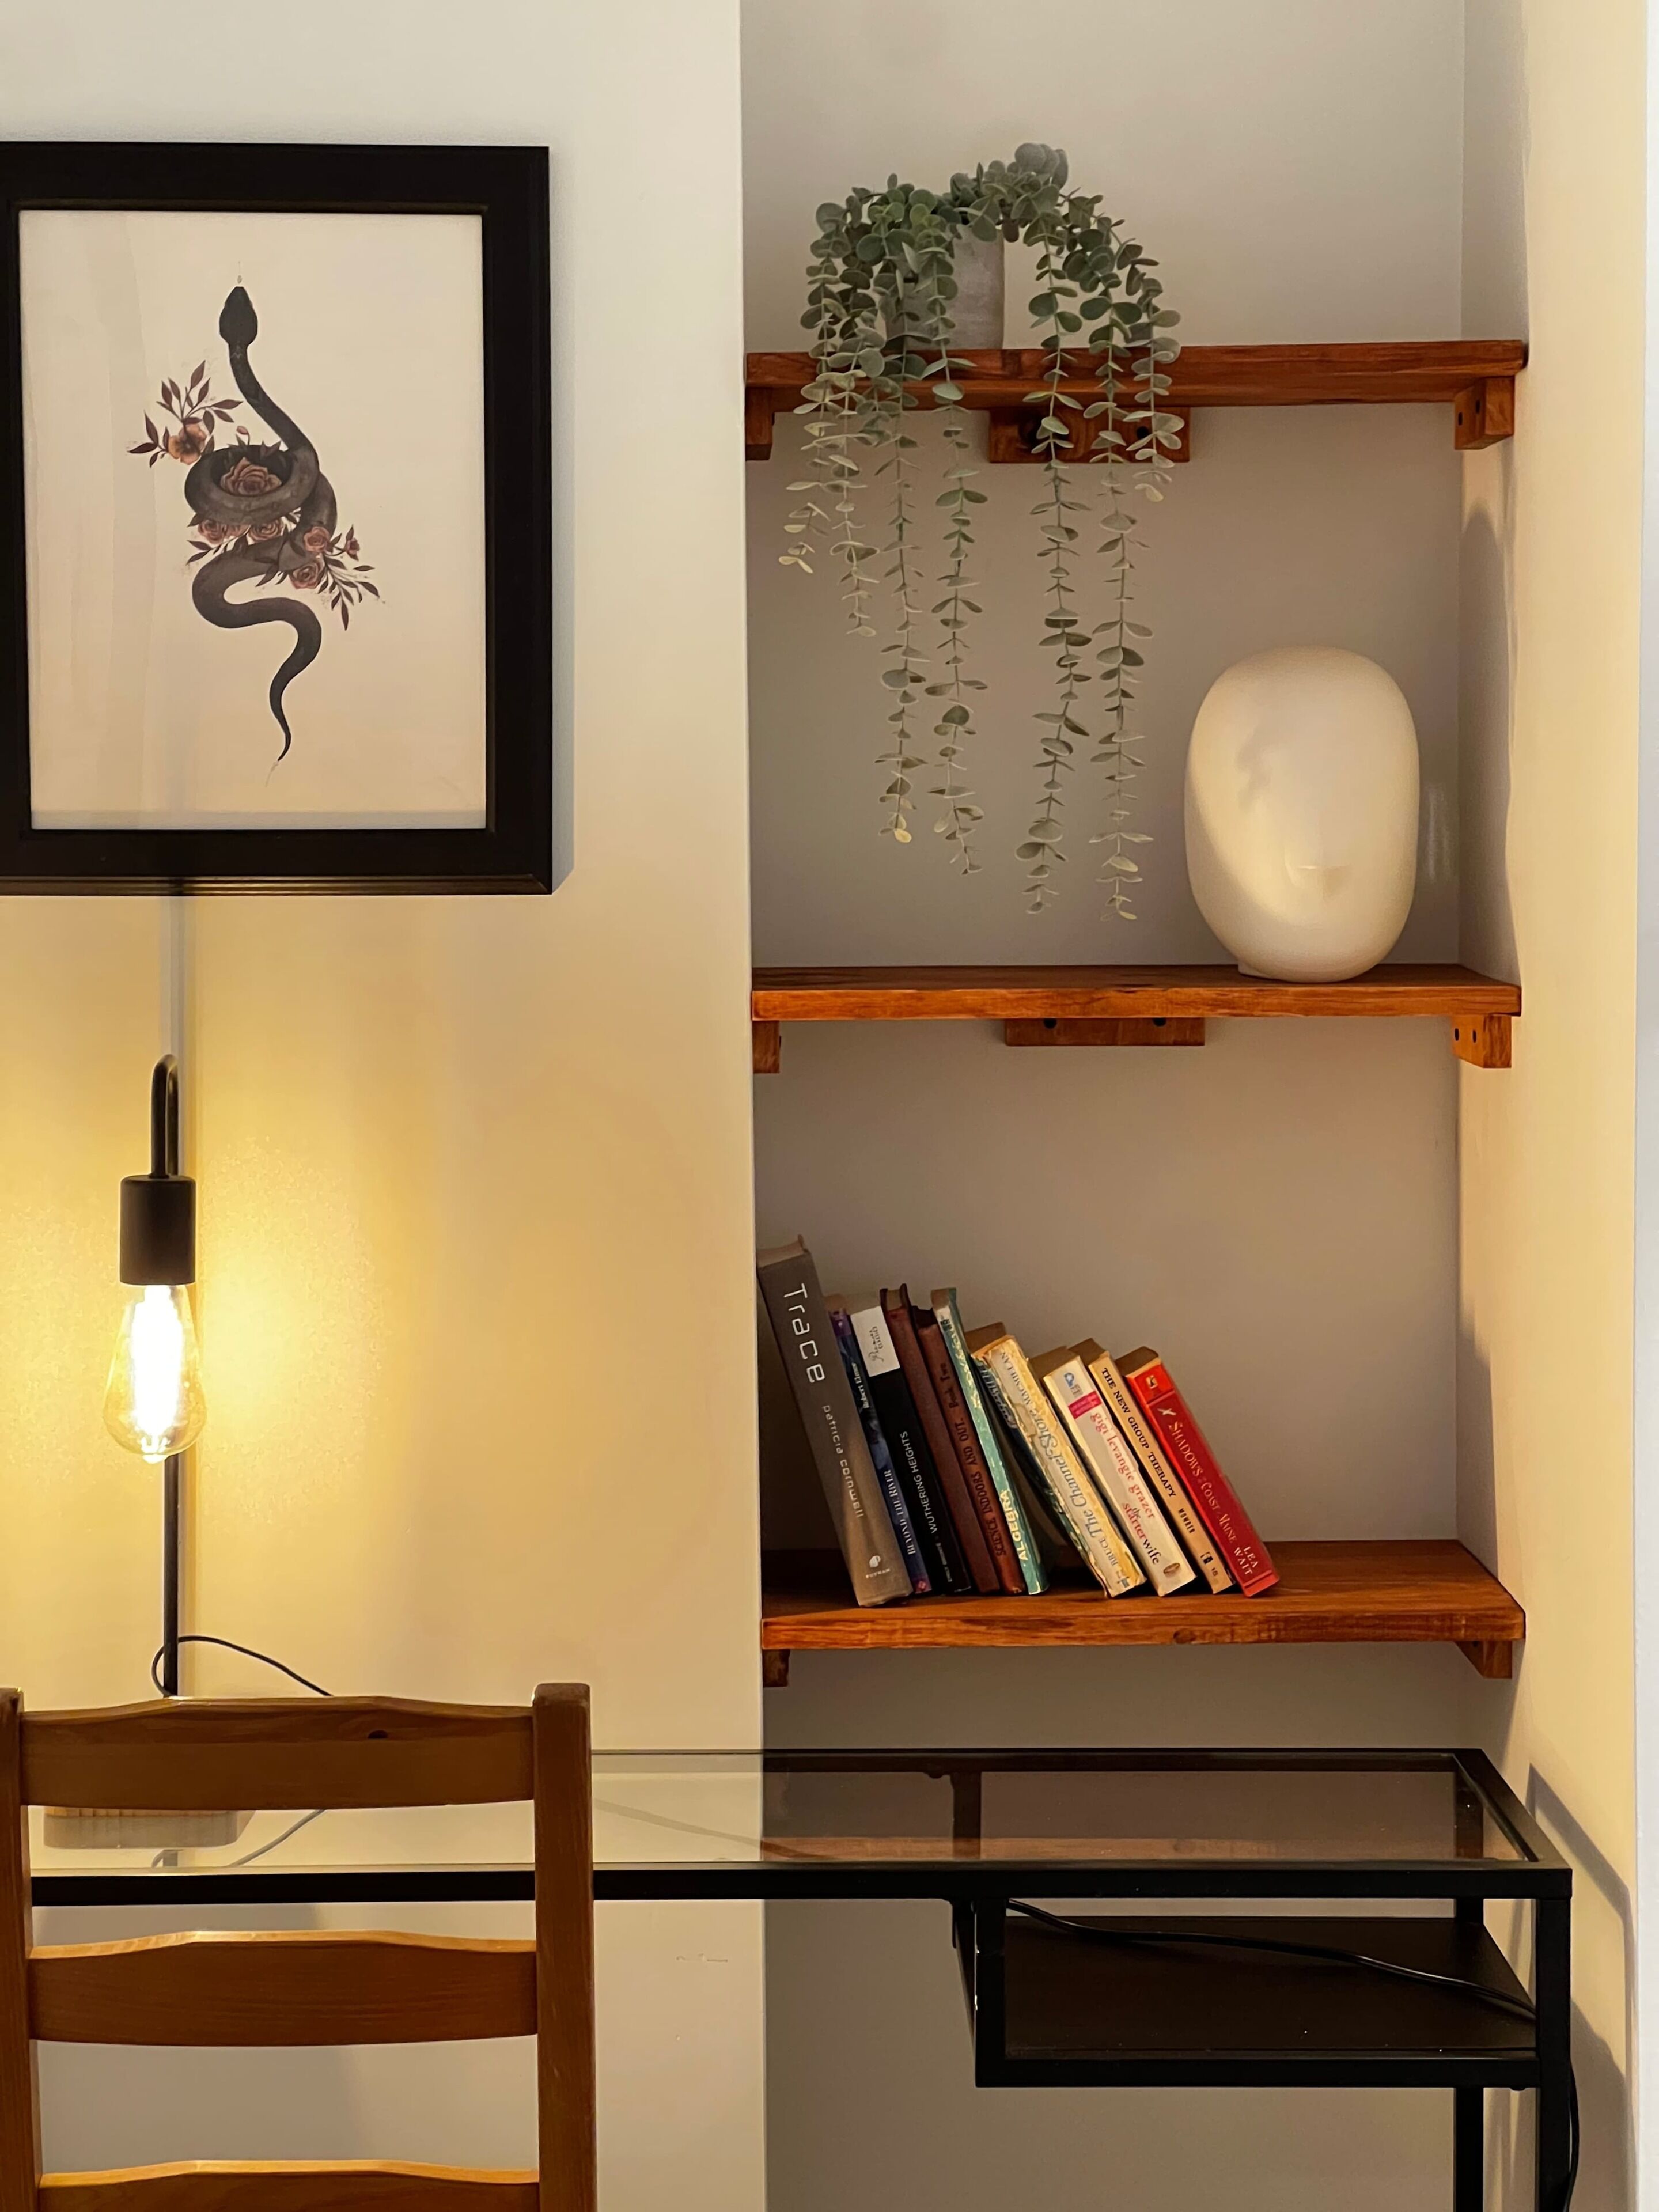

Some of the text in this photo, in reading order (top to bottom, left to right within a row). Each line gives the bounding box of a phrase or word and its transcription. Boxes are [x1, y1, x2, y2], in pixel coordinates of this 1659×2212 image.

[783, 1283, 825, 1383] Trace
[1001, 1352, 1031, 1405] MACMILLAN
[940, 1363, 1006, 1556] SCIENCE INDOORS AND OUT. Book Two
[1029, 1410, 1058, 1460] Shore
[1101, 1368, 1176, 1497] THE NEW GROUP THERAPY
[822, 1405, 864, 1518] patricia cornwell
[884, 1469, 898, 1497] RIVER
[900, 1431, 938, 1533] WUTHERING HEIGHTS
[1055, 1451, 1087, 1507] Channel
[1090, 1413, 1155, 1519] gigi levangie grazer
[1169, 1421, 1203, 1477] SHADOWS
[1200, 1482, 1220, 1510] COAST
[1218, 1513, 1237, 1544] MAINE
[1000, 1490, 1028, 1560] ALGEBRA
[1084, 1509, 1103, 1538] The
[1178, 1508, 1195, 1534] MOWRER
[1099, 1537, 1118, 1566] BRUCE
[1234, 1547, 1253, 1575] WAIT
[1243, 1546, 1259, 1568] LEA
